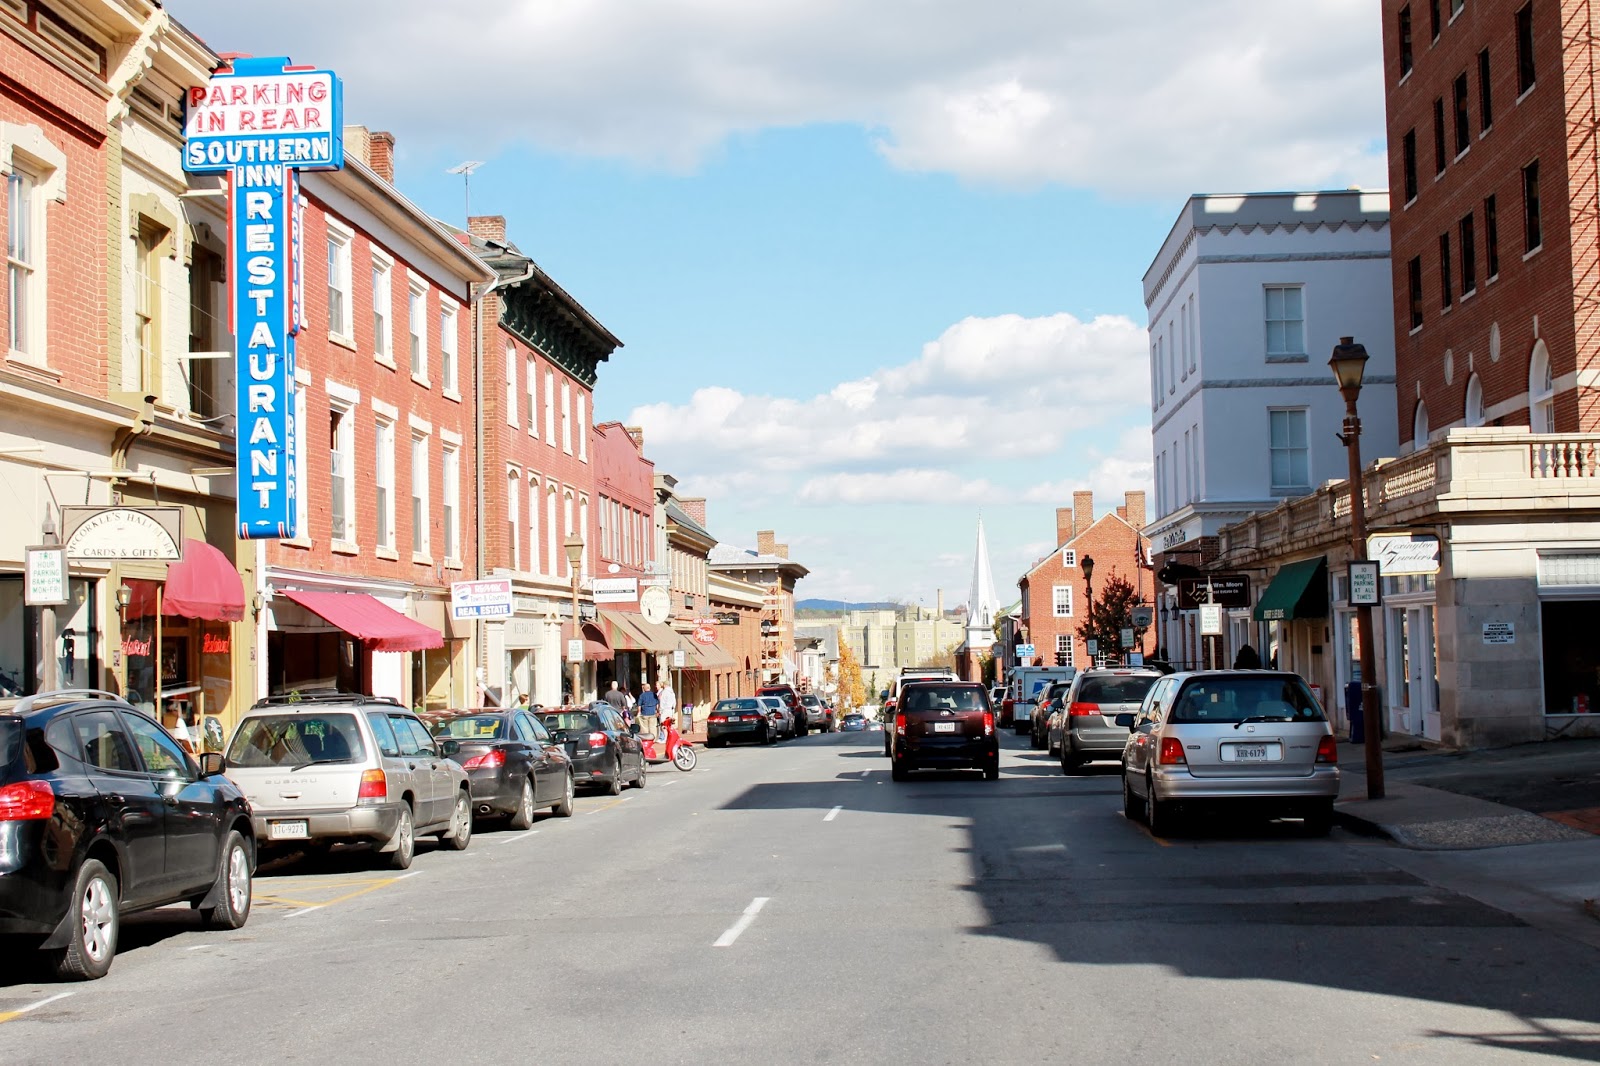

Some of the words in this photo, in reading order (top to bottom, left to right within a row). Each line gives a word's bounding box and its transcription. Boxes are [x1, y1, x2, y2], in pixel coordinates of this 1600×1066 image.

[190, 81, 327, 107] PARKING
[197, 111, 226, 133] IN
[239, 107, 322, 131] REAR
[189, 137, 329, 164] SOUTHERN
[237, 164, 283, 188] INN
[246, 191, 278, 509] RESTAURANT
[120, 548, 127, 556] &
[132, 548, 159, 556] GIFTS
[33, 569, 60, 577] PARKING
[458, 606, 480, 616] REAL
[480, 604, 509, 614] ESTATE
[265, 777, 317, 785] SUBARU
